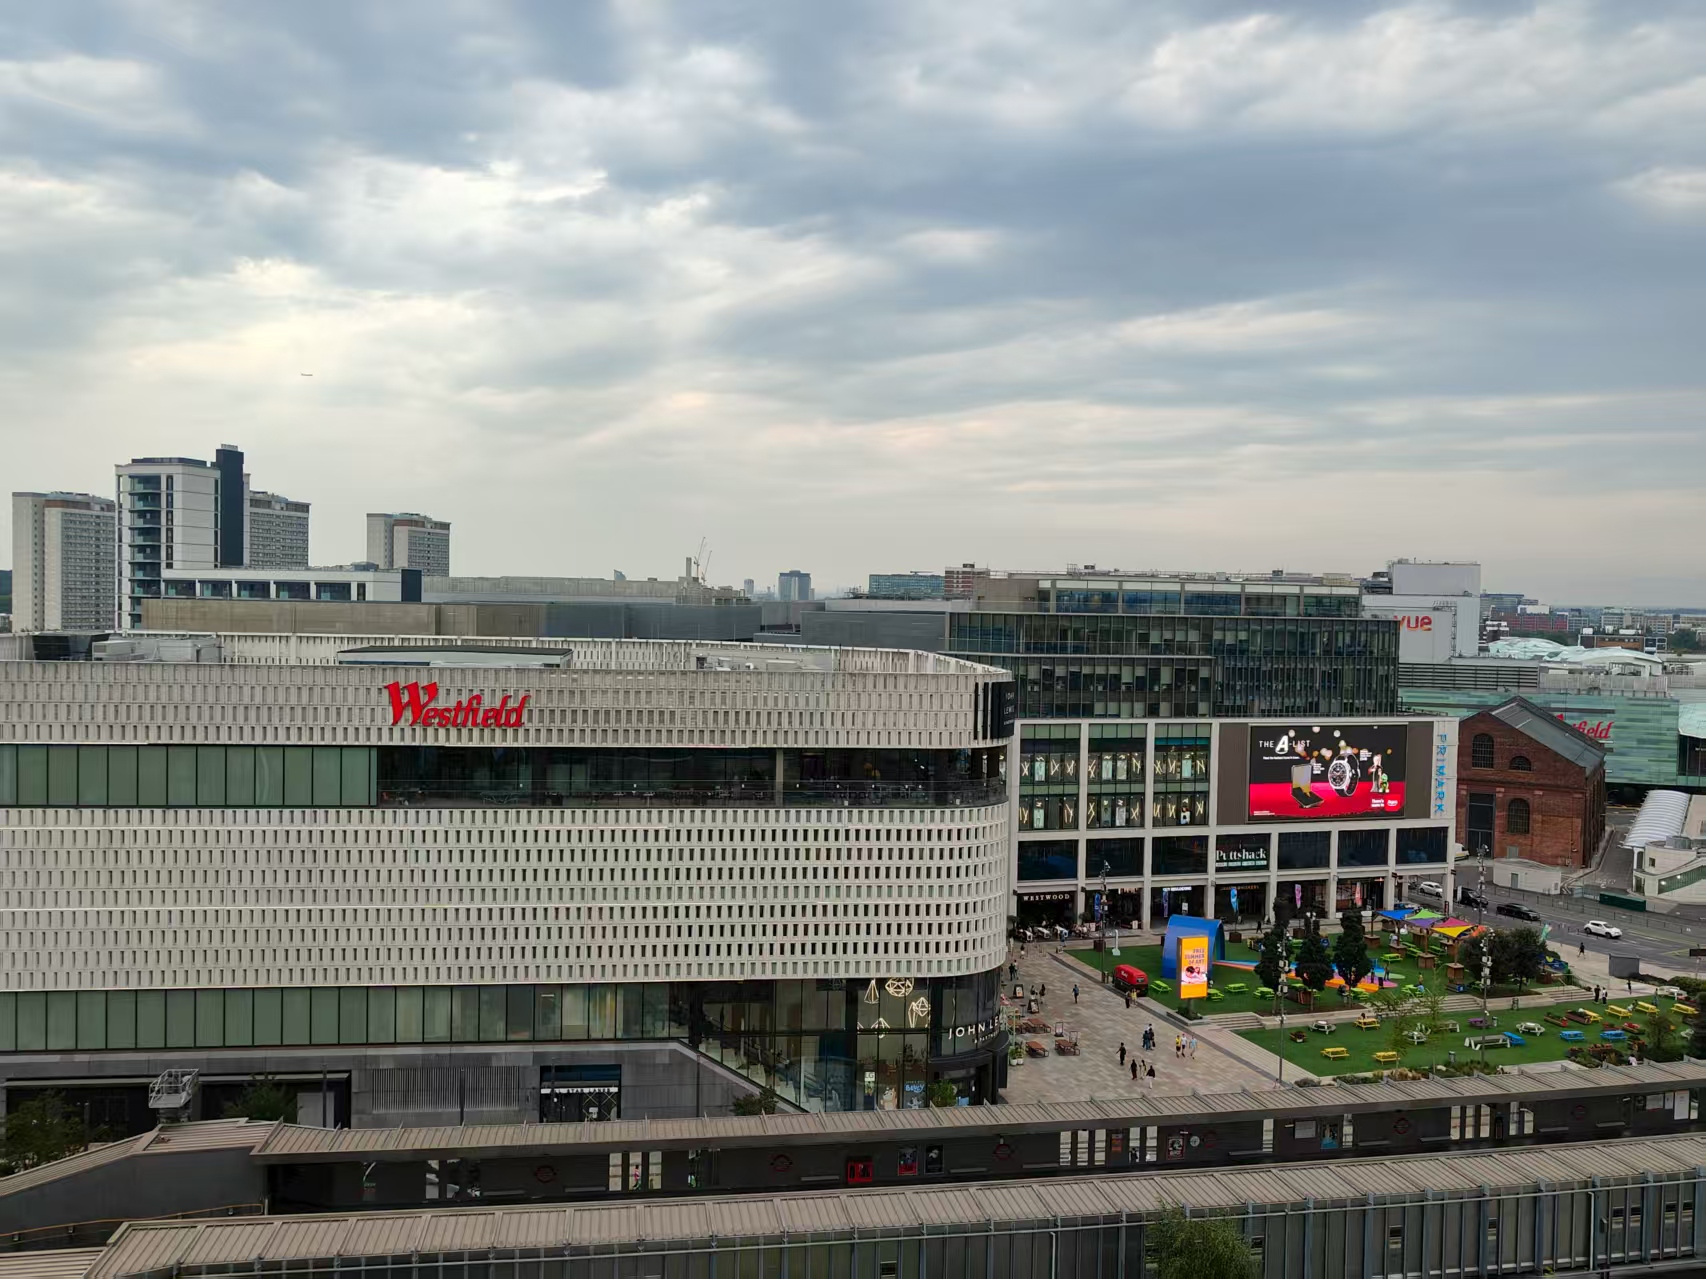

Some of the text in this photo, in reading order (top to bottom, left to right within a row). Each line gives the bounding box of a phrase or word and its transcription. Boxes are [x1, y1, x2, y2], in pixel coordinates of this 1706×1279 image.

[384, 681, 532, 728] Westfield
[1259, 735, 1311, 755] THE A-LIST
[1434, 734, 1447, 814] PRIMARK
[1216, 848, 1267, 860] Puttshack
[1023, 893, 1070, 901] WESTWOOD
[948, 1022, 986, 1040] JOHN
